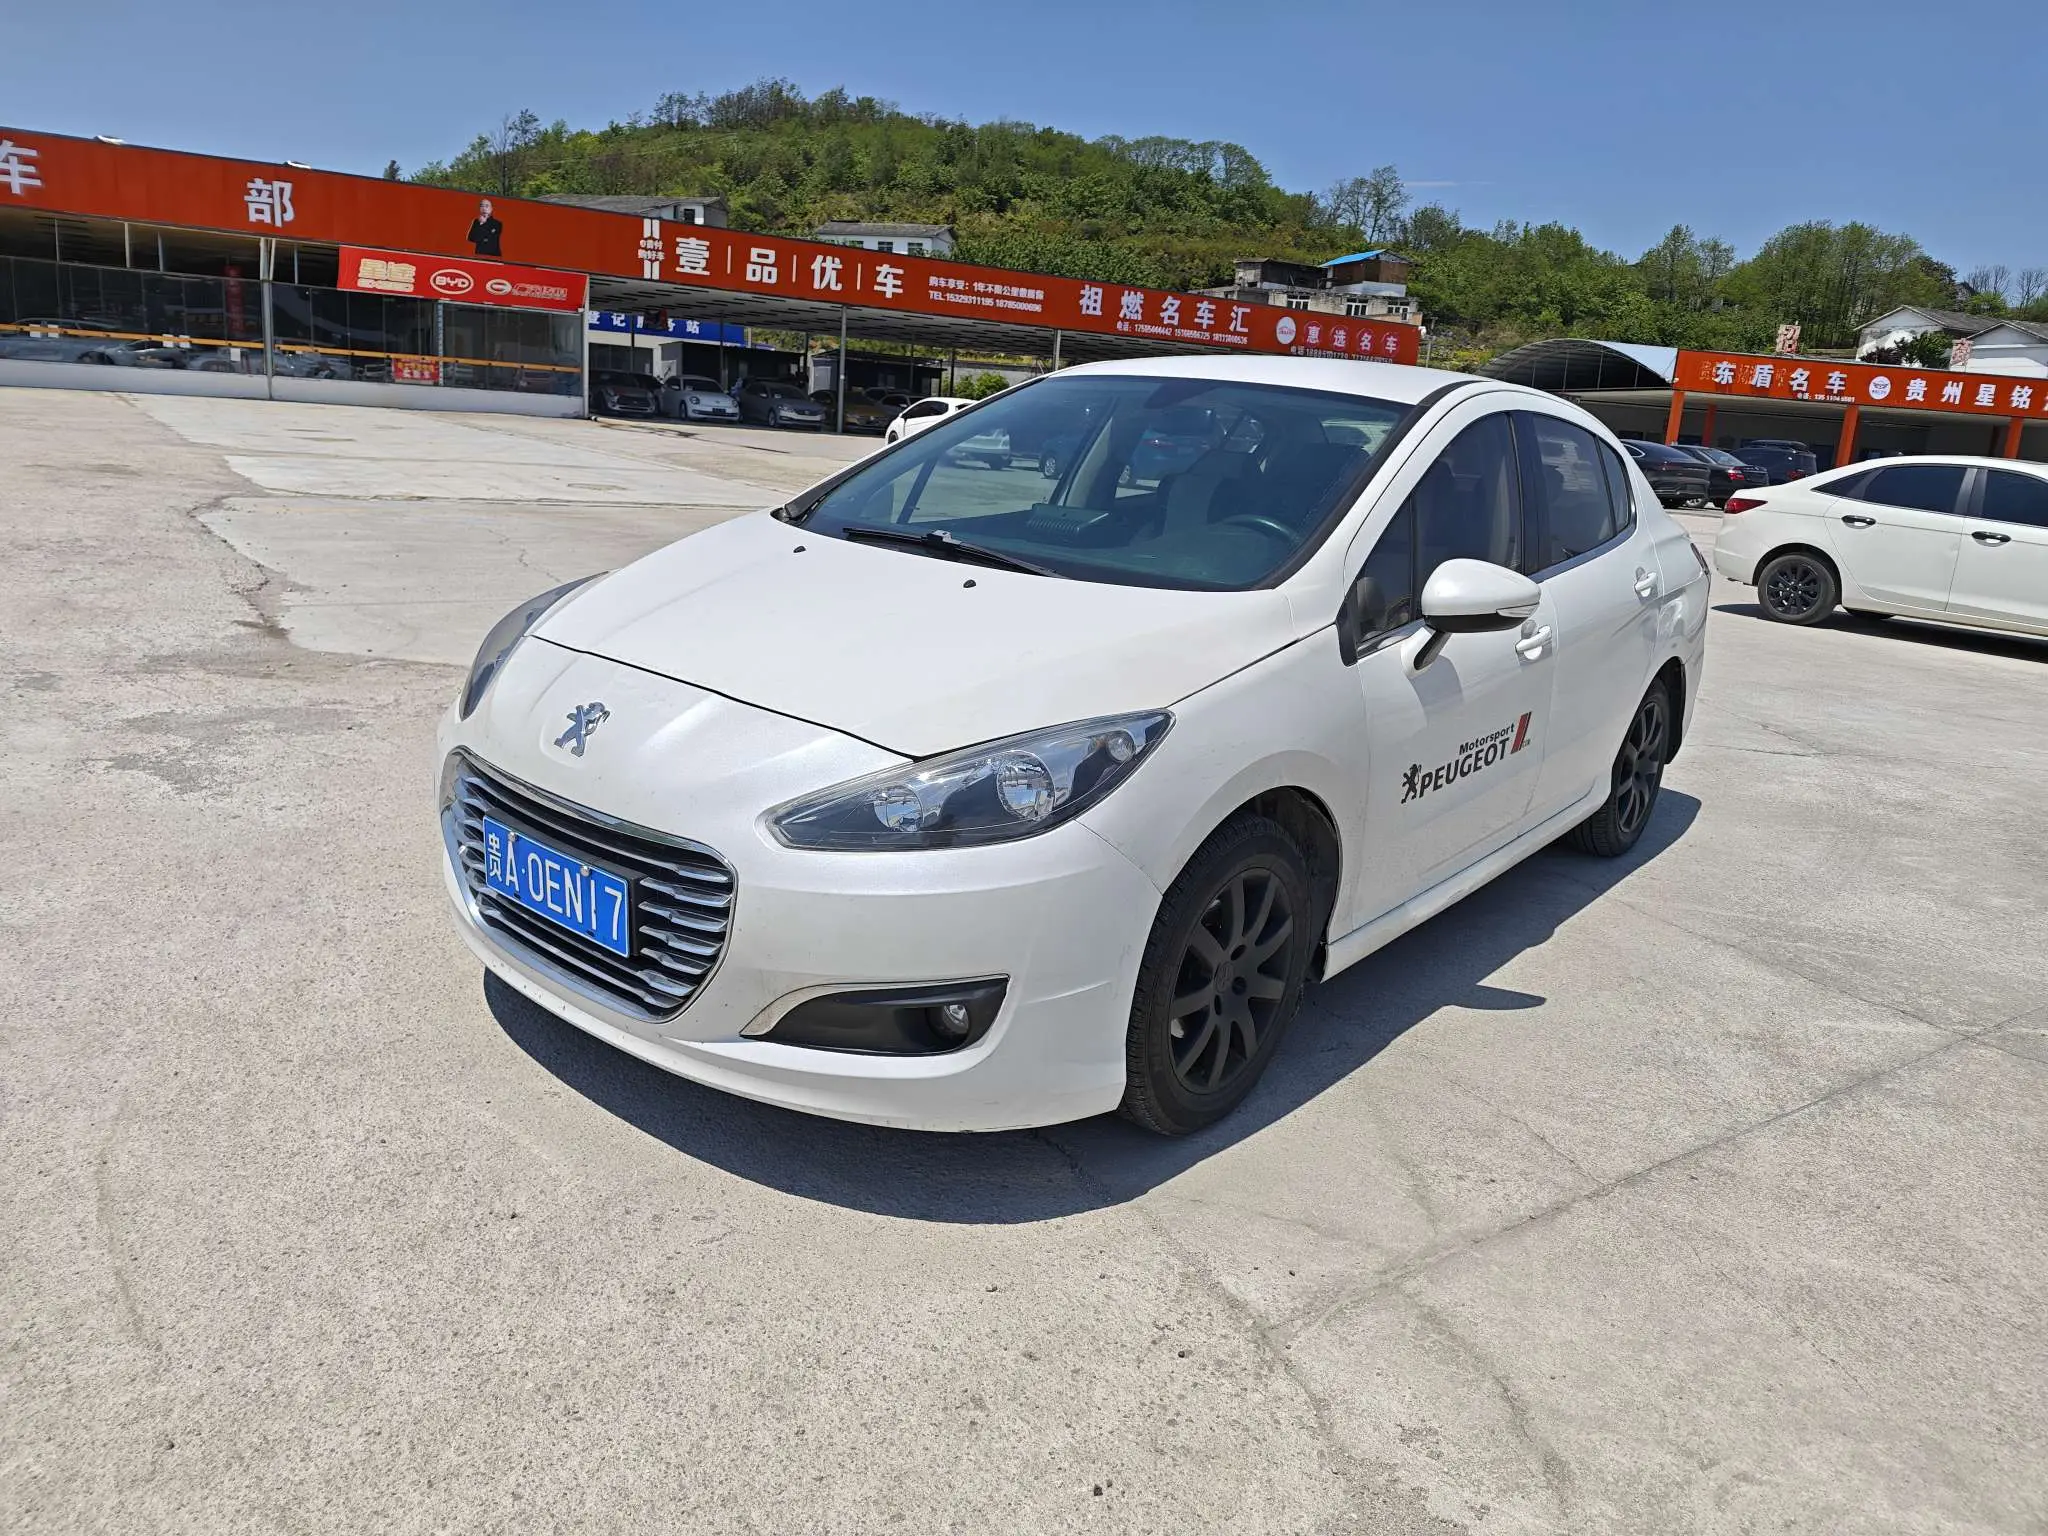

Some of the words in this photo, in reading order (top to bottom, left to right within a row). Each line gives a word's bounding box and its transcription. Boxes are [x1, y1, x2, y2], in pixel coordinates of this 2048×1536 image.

[244, 178, 294, 228] 部
[435, 275, 469, 289] BYD
[1079, 284, 1251, 333] 祖燃名车汇
[1307, 326, 1398, 353] 惠选名车
[1714, 361, 1848, 393] 东盾名车
[1906, 378, 2048, 412] 贵州星铭
[1459, 723, 1515, 755] Motorsport
[1419, 738, 1510, 798] PEUGEOT
